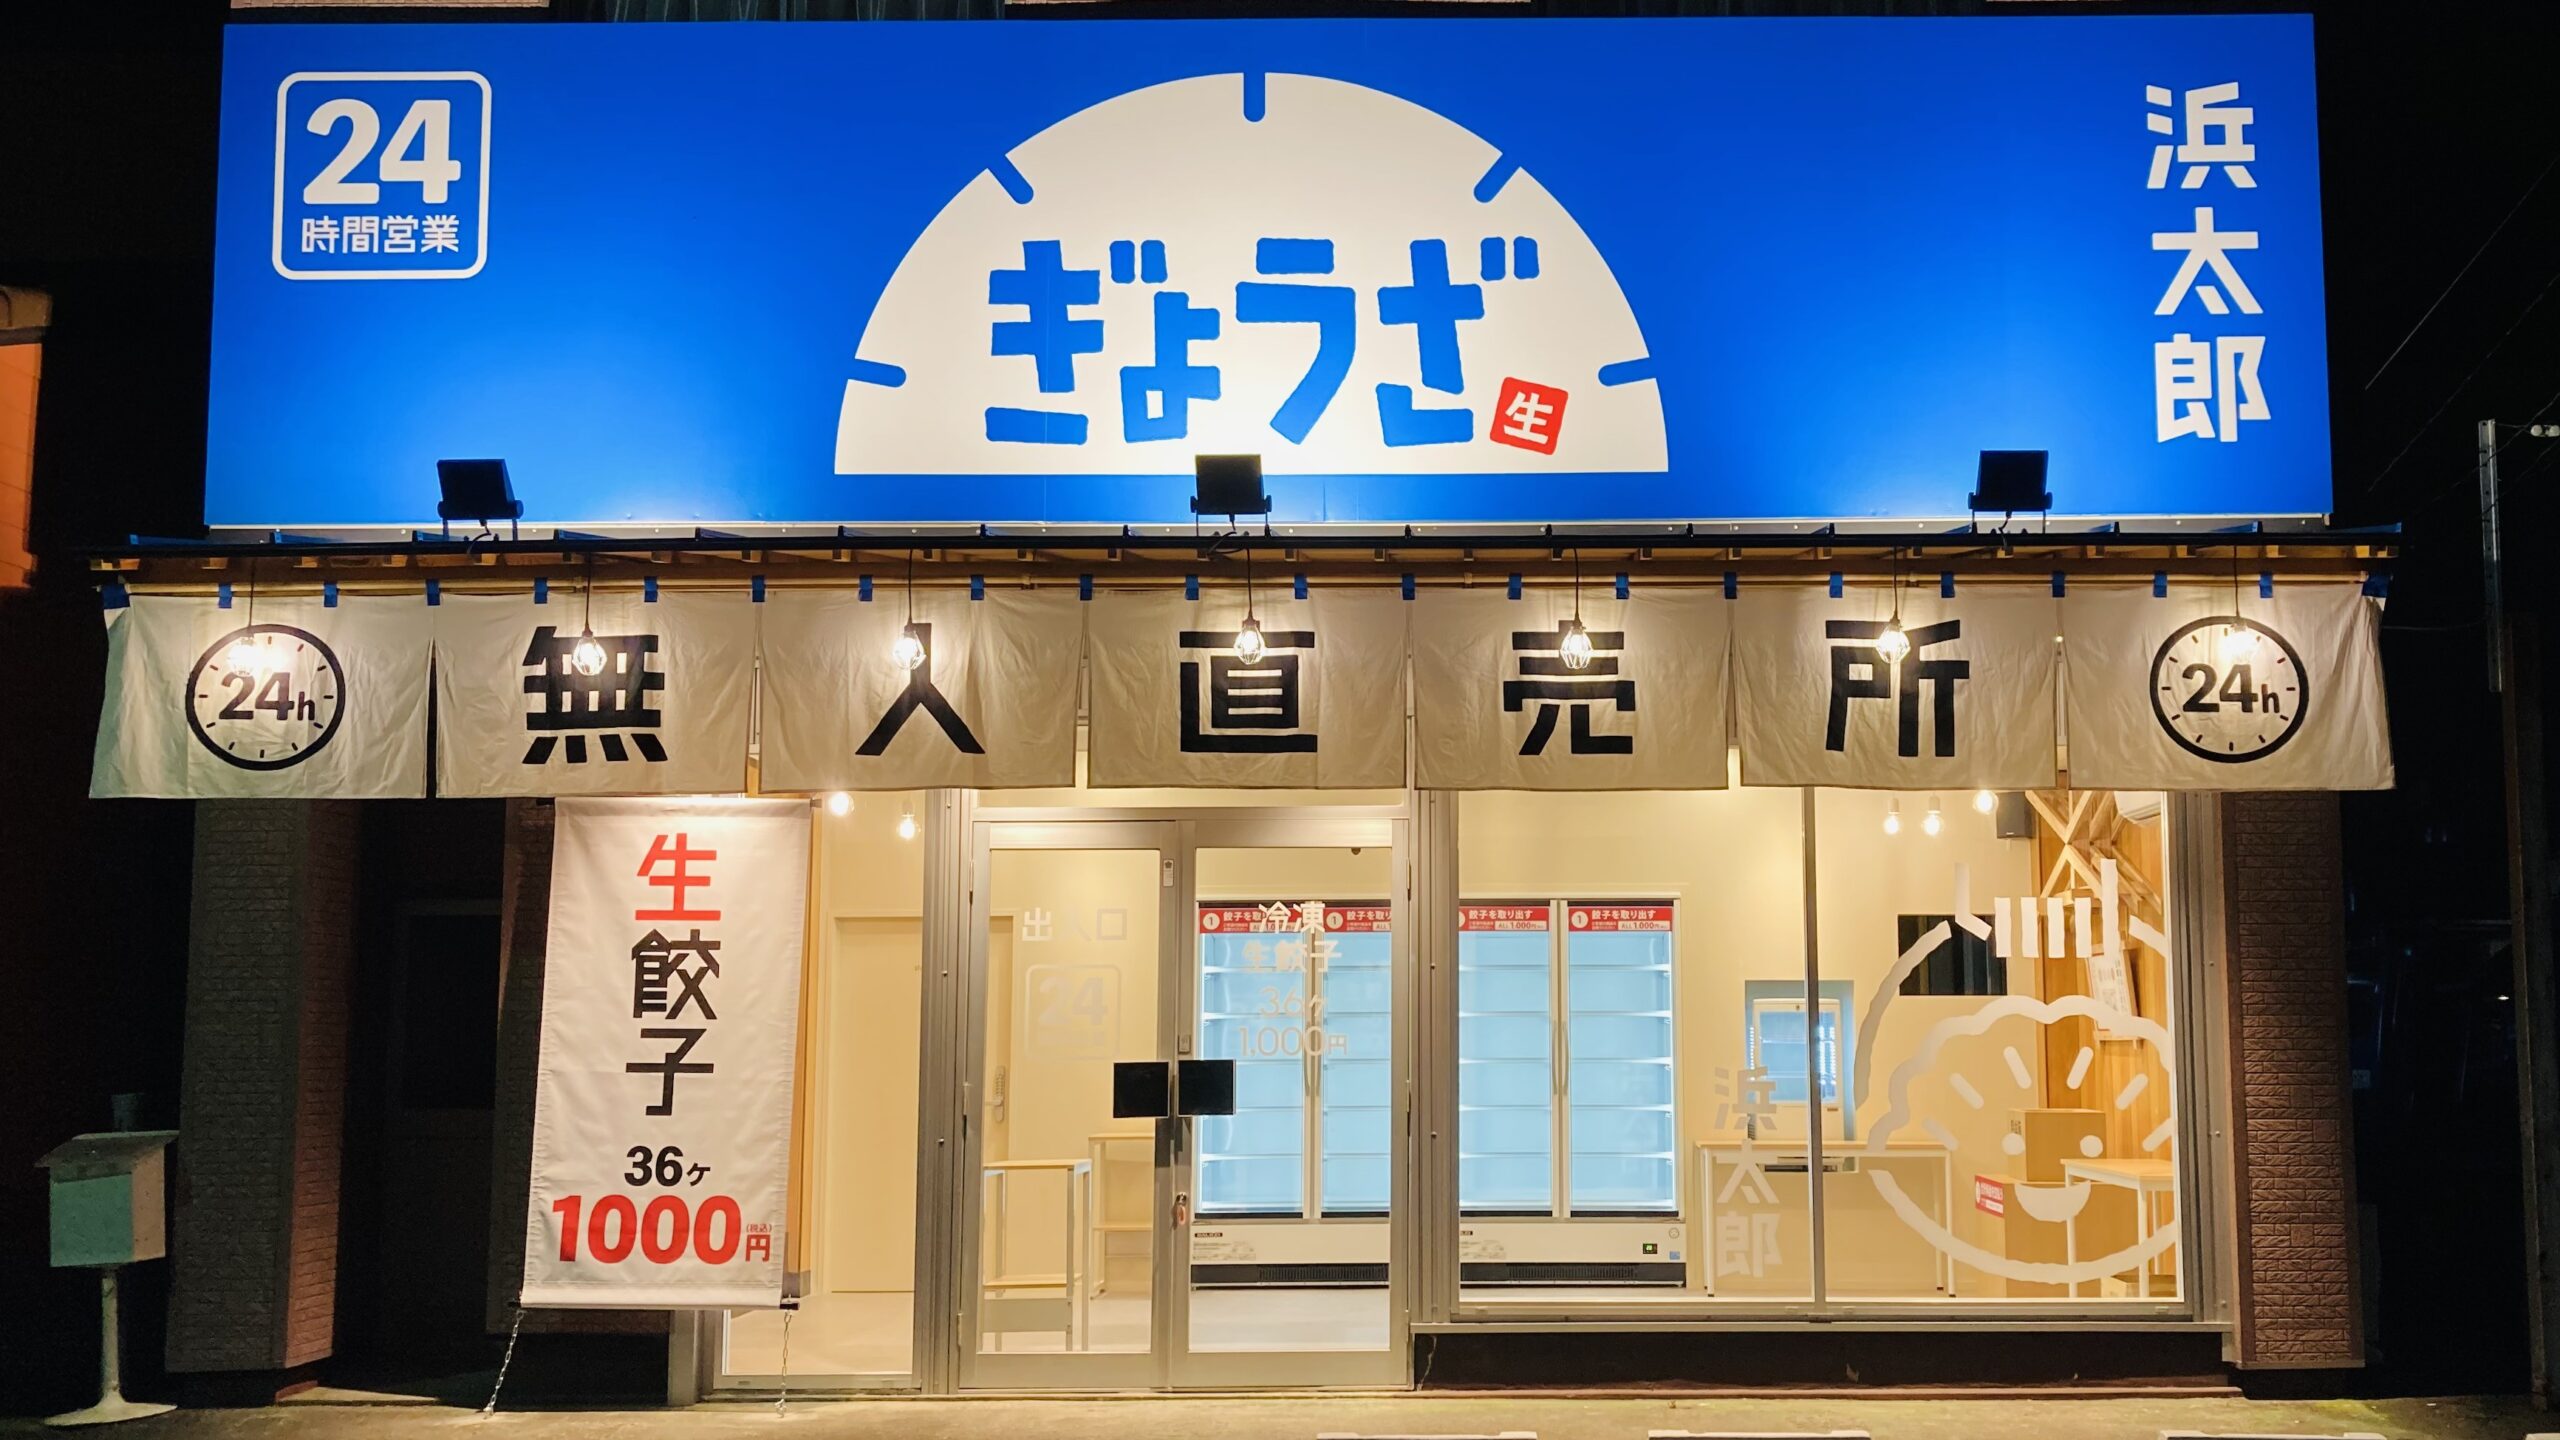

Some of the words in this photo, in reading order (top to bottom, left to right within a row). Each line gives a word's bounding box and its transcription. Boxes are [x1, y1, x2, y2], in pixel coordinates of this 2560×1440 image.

[303, 98, 461, 205] 24
[301, 214, 460, 254] 時間営業
[2146, 81, 2272, 443] 浜太郎
[985, 237, 1540, 447] ぎょうざ
[1503, 390, 1556, 445] 生
[218, 671, 316, 723] 24h
[522, 617, 1971, 762] 無人直売所
[2181, 662, 2281, 714] 24h
[1021, 906, 1128, 943] 出入口
[1258, 900, 1326, 934] 冷凍
[1591, 909, 1656, 920] 餃子を取り出す
[624, 832, 722, 1117] 生餃子
[1241, 939, 1343, 974] 生餃子
[1038, 975, 1109, 1027] 24
[1713, 1065, 1783, 1280] 浜太郎
